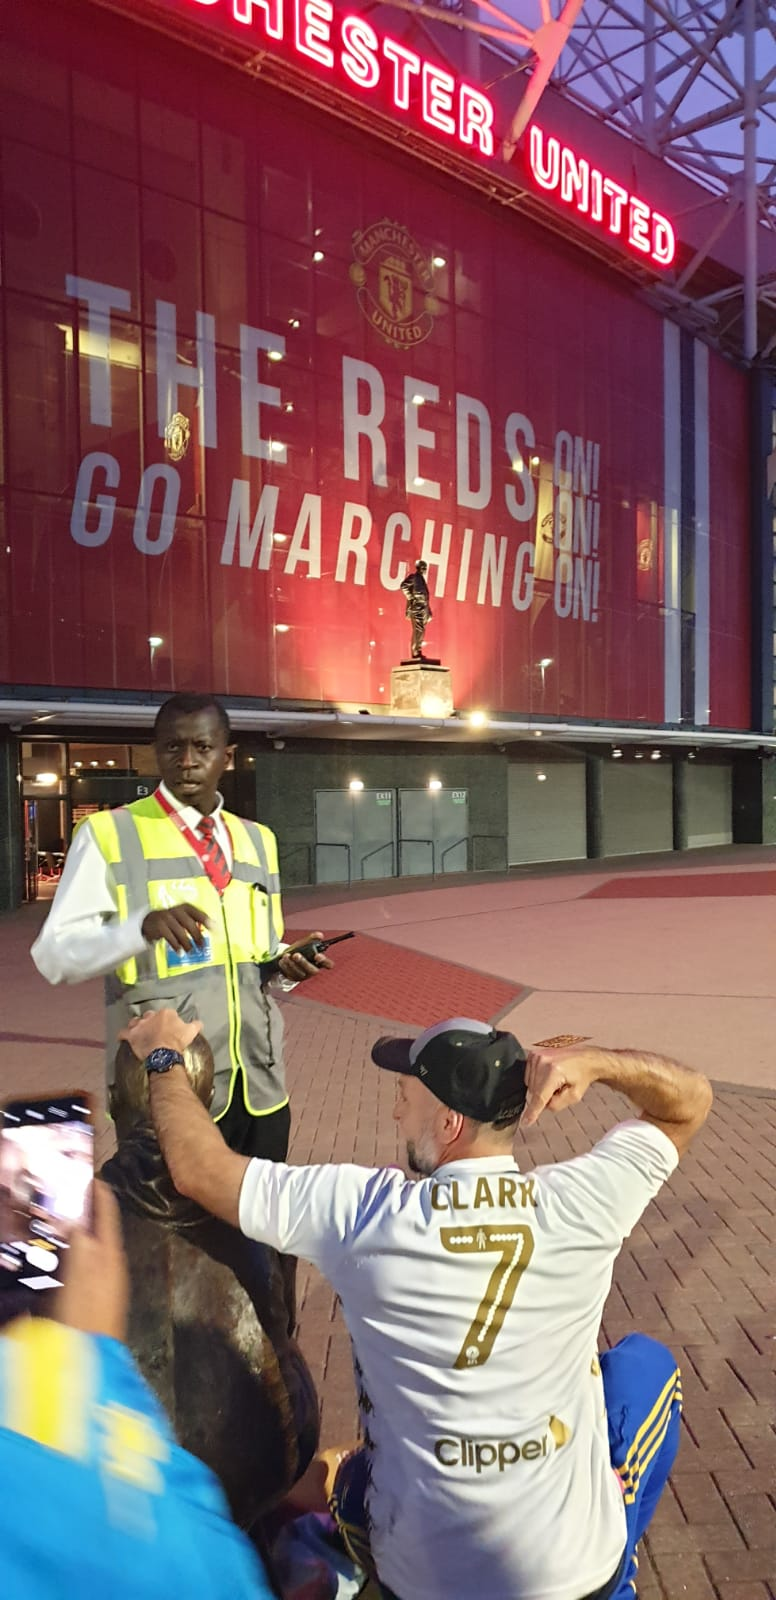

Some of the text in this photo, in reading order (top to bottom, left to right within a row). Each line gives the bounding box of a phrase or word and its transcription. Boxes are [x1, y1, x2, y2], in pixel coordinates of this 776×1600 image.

[190, 0, 675, 264] HESTER UNITED
[371, 310, 422, 340] UNITED
[65, 273, 536, 522] THE REDS
[554, 430, 600, 498] ON!
[70, 451, 535, 612] GO MARCHING
[554, 485, 600, 558] ON!
[554, 553, 600, 622] ON!
[137, 785, 149, 796] E3
[431, 1176, 538, 1211] CLARK
[440, 1224, 535, 1370] 7
[434, 1433, 548, 1474] Clipper
